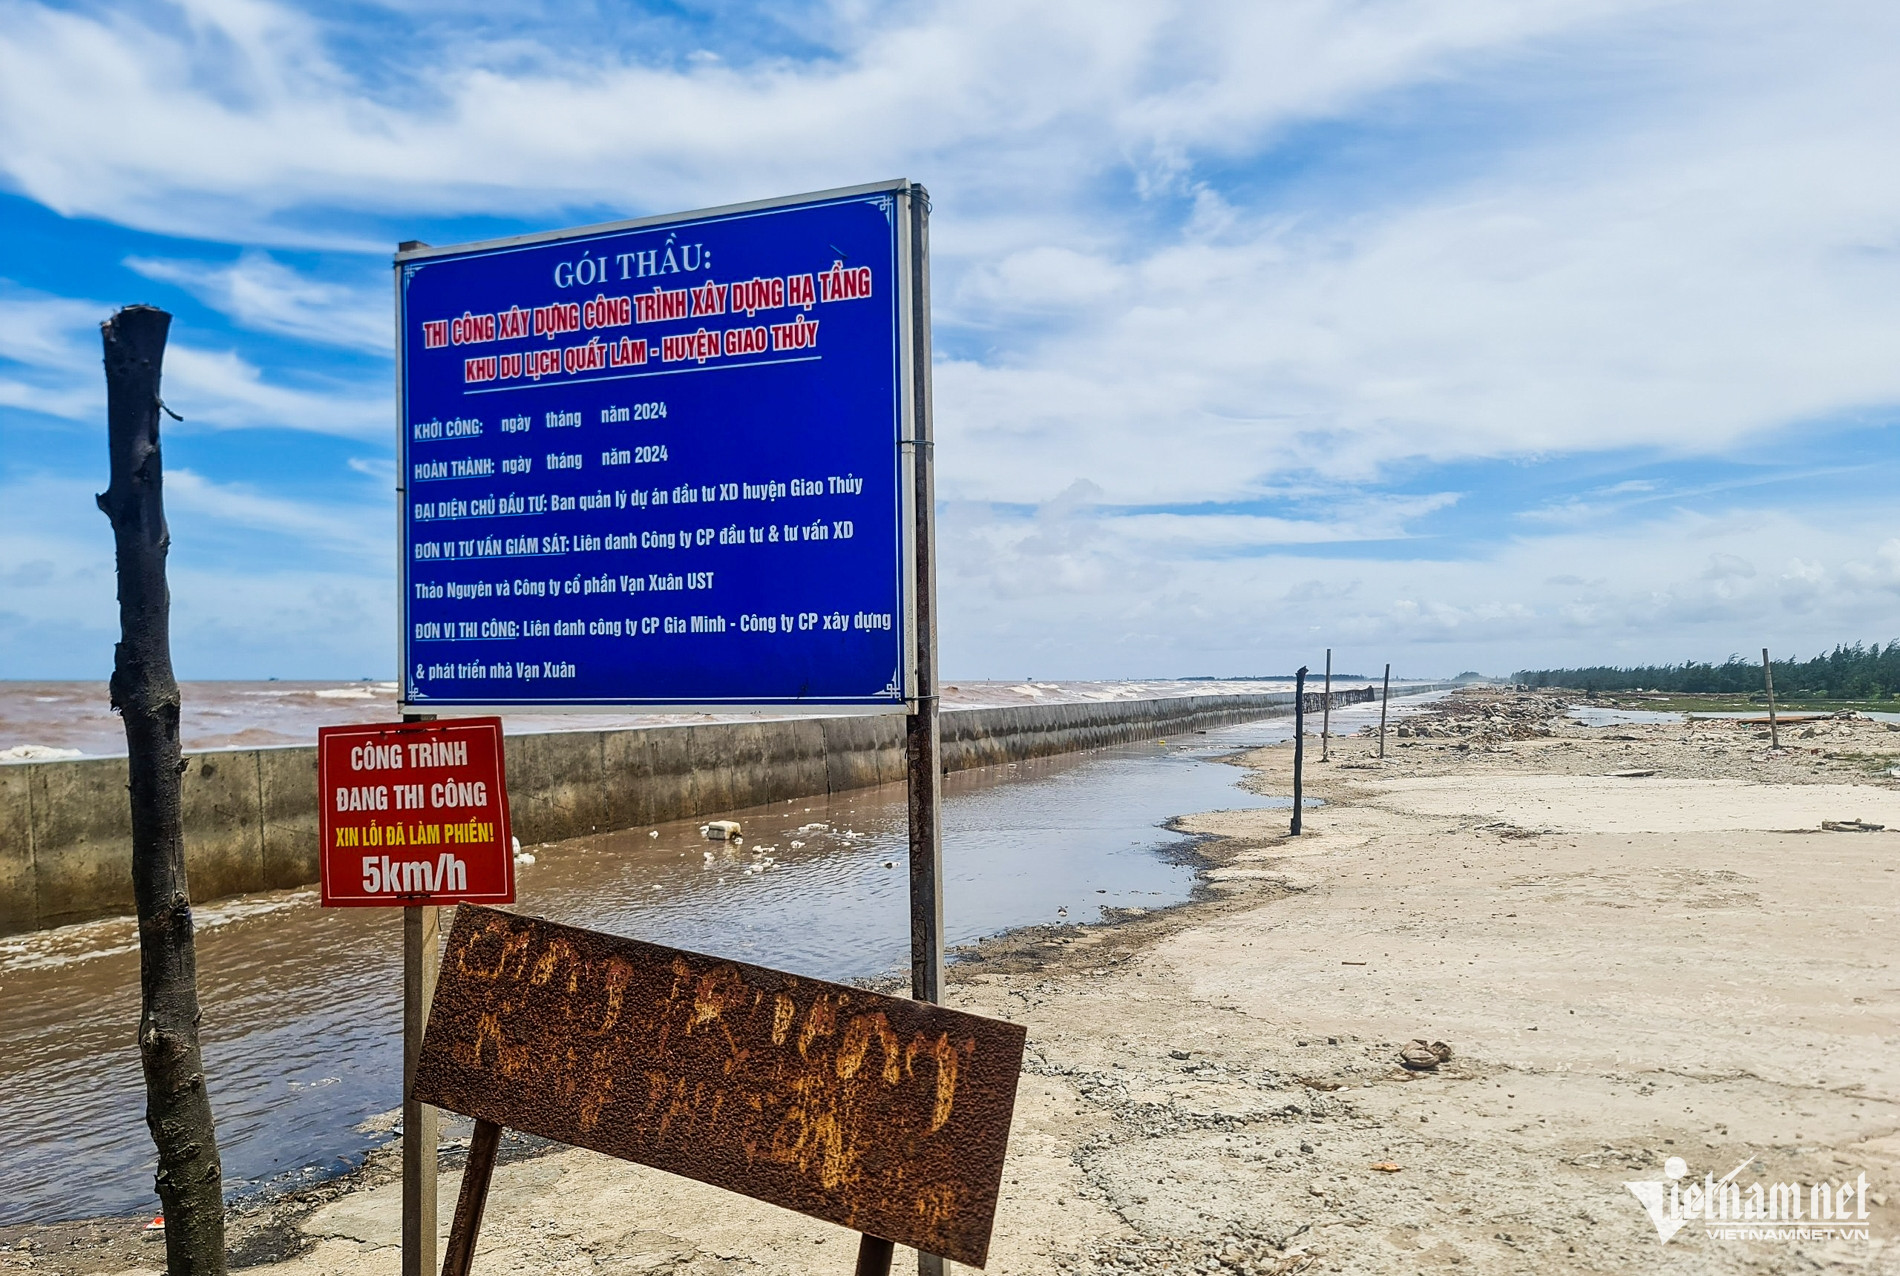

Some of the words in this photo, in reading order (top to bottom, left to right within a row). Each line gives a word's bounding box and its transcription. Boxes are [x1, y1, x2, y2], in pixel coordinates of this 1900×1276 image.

[554, 251, 608, 288] GÓI
[616, 232, 711, 281] THẦU:
[423, 320, 448, 348] THI
[452, 312, 495, 346] CÔNG
[498, 305, 531, 340] XÂY
[534, 301, 580, 339] DỰNG
[583, 294, 631, 329] CÔNG
[634, 286, 688, 323] TRÌNH
[690, 280, 728, 318] XÂY
[731, 277, 784, 317] DỰNG
[787, 273, 816, 311] HẠ
[818, 260, 872, 302] TẦNG
[465, 357, 497, 383] KHU
[500, 353, 522, 379] DU
[525, 350, 561, 380] LỊCH
[564, 336, 607, 374] QUẤT
[610, 336, 648, 368] LÂM
[662, 328, 721, 364] HUYỆN
[724, 326, 768, 356] GIAO
[770, 314, 819, 351] THỦY
[414, 417, 442, 439] KHỞI
[446, 417, 483, 437] CÔNG:
[502, 414, 531, 433] ngày
[546, 410, 581, 428] tháng
[601, 406, 630, 423] năm
[634, 402, 667, 421] 2024
[414, 461, 448, 479] HOÀN
[451, 456, 495, 477] THÀNH:
[502, 455, 532, 474] ngày
[547, 452, 583, 470] tháng
[602, 448, 631, 466] năm
[634, 445, 668, 463] 2024
[415, 503, 435, 522] ĐẠI
[438, 498, 467, 520] DIỆN
[471, 494, 496, 514] CHỦ
[499, 492, 525, 514] ĐẦU
[528, 494, 548, 512] TƯ:
[551, 494, 575, 511] Ban
[580, 490, 611, 511] quản
[615, 490, 627, 508] lý
[631, 490, 648, 510] dự
[652, 489, 668, 506] án
[673, 483, 697, 503] đầu
[702, 486, 716, 502] tư
[719, 483, 739, 501] XD
[743, 480, 786, 501] huyện
[790, 479, 824, 497] Giao
[828, 473, 863, 495] Thủy
[415, 543, 440, 559] ĐƠN
[444, 542, 455, 560] VỊ
[459, 539, 474, 557] TƯ
[477, 534, 502, 555] VẤN
[505, 535, 539, 554] GIÁM
[542, 534, 569, 553] SÁT:
[573, 534, 601, 552] Liên
[605, 533, 637, 550] danh
[641, 531, 676, 549] Công
[679, 530, 692, 549] ty
[696, 528, 715, 546] CP
[719, 524, 745, 545] đầu
[750, 527, 764, 543] tư
[768, 525, 779, 542] &
[784, 525, 798, 541] tư
[803, 519, 829, 540] vấn
[833, 521, 854, 539] XD
[415, 581, 443, 599] Thảo
[447, 581, 492, 600] Nguyên
[496, 579, 510, 596] và
[514, 579, 546, 597] Công
[549, 579, 560, 596] ty
[564, 574, 581, 594] cổ
[584, 573, 616, 595] phần
[620, 575, 645, 595] Vạn
[649, 573, 683, 591] Xuân
[687, 572, 714, 590] UST
[415, 623, 440, 639] ĐƠN
[444, 622, 455, 641] VỊ
[459, 621, 478, 638] THI
[481, 618, 519, 638] CÔNG:
[523, 620, 550, 637] Liên
[554, 619, 585, 635] danh
[589, 618, 621, 637] công
[625, 619, 637, 636] ty
[641, 617, 660, 634] CP
[664, 616, 687, 634] Gia
[691, 615, 726, 633] Minh
[740, 614, 777, 633] Công
[781, 615, 794, 632] ty
[798, 613, 818, 630] CP
[823, 612, 849, 631] xây
[854, 612, 891, 632] dựng
[416, 664, 425, 679] &
[429, 663, 455, 681] phát
[458, 659, 486, 679] triển
[490, 662, 513, 678] nhà
[517, 662, 539, 681] Vạn
[544, 661, 576, 678] Xuân
[351, 741, 402, 771] CÔNG
[408, 737, 468, 768] TRÌNH
[336, 785, 388, 812] ĐANG
[393, 784, 424, 809] THI
[431, 778, 488, 807] CÔNG
[336, 827, 359, 847] XIN
[363, 819, 383, 846] LỖI
[386, 822, 405, 845] ĐÃ
[409, 821, 441, 845] LÀM
[445, 816, 494, 844] PHIỀN!
[362, 853, 467, 893] 5km/h
